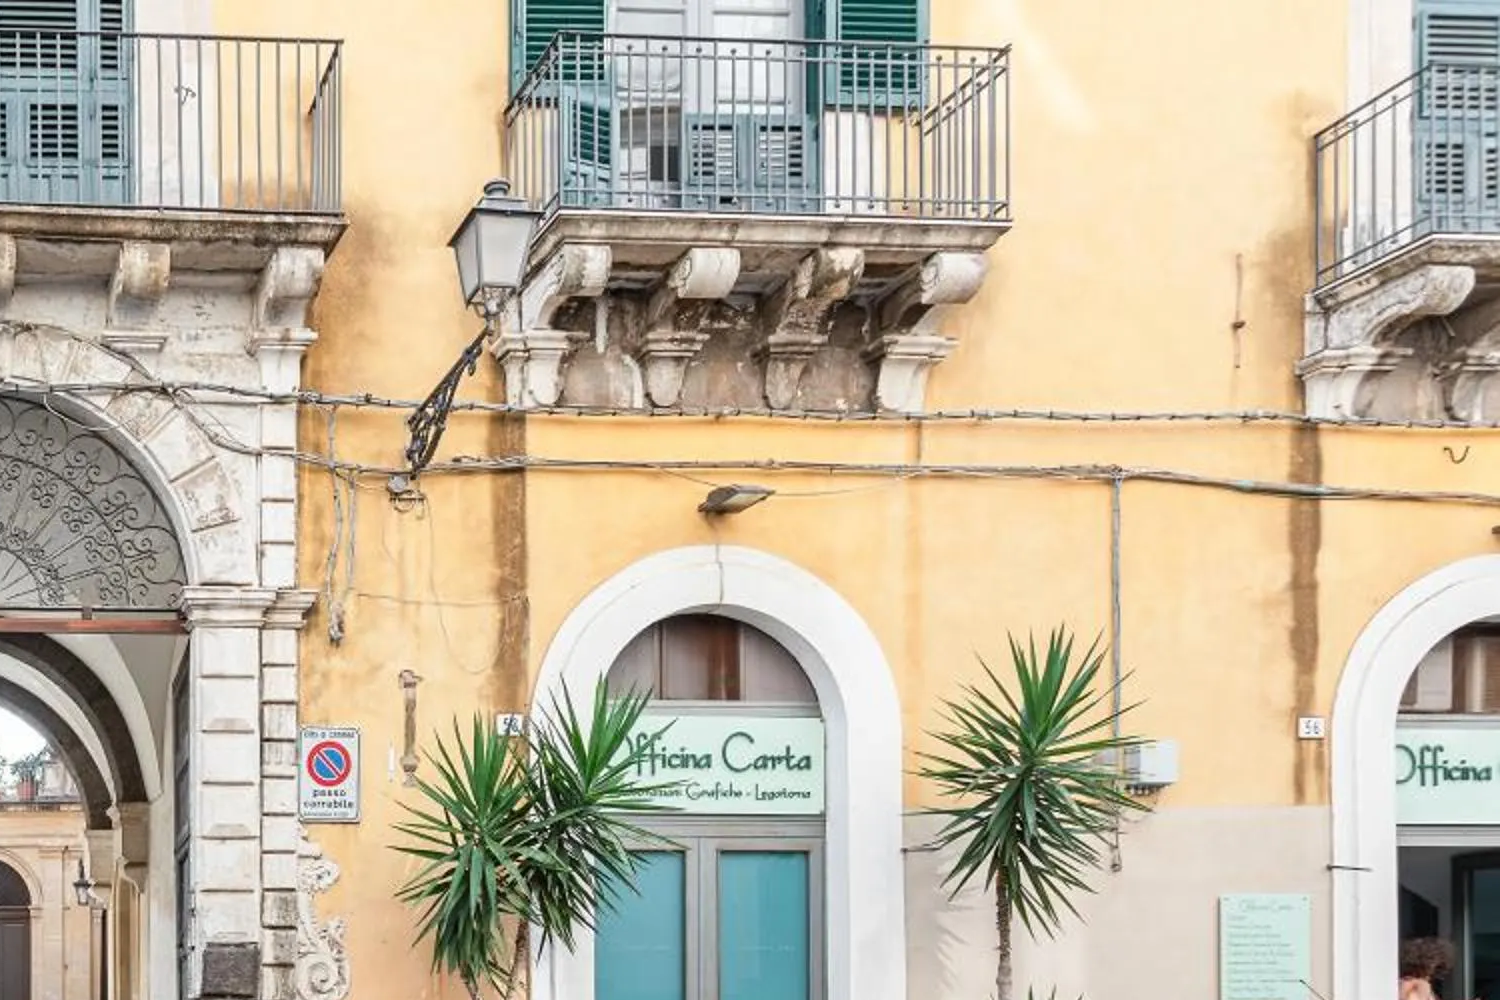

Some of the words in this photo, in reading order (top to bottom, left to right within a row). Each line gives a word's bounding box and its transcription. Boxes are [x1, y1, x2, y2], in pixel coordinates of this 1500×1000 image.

[624, 731, 713, 777] fficina
[721, 731, 812, 773] Carta
[313, 789, 347, 798] passo
[685, 781, 743, 800] Grafiche
[303, 800, 354, 809] carrabile
